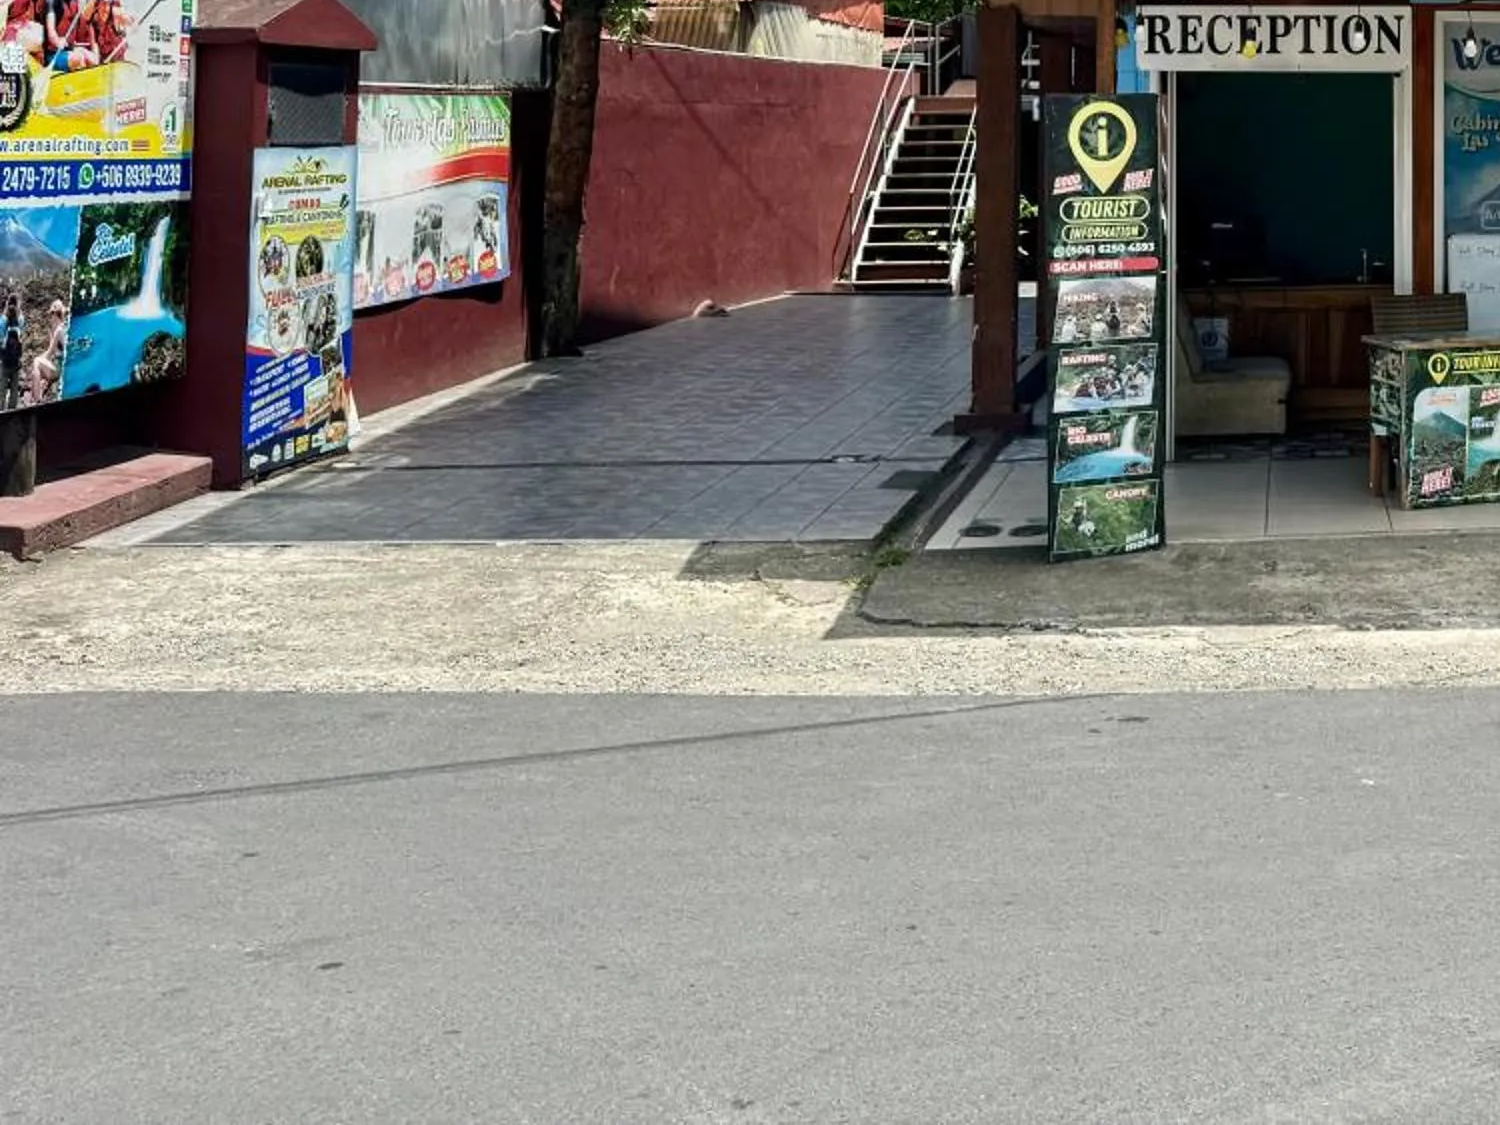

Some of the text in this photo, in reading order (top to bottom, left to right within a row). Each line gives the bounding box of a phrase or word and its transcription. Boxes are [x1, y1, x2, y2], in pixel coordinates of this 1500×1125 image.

[1143, 13, 1405, 56] RECEPTION
[1461, 131, 1489, 152] Las
[2, 165, 71, 191] 2479-7215
[1071, 199, 1139, 220] TOURIST
[1069, 225, 1140, 241] INFORMATION
[1053, 261, 1087, 273] SCAN
[1061, 353, 1107, 365] RAFTING
[1453, 355, 1481, 371] TOUR
[1105, 488, 1148, 500] CANOPY
